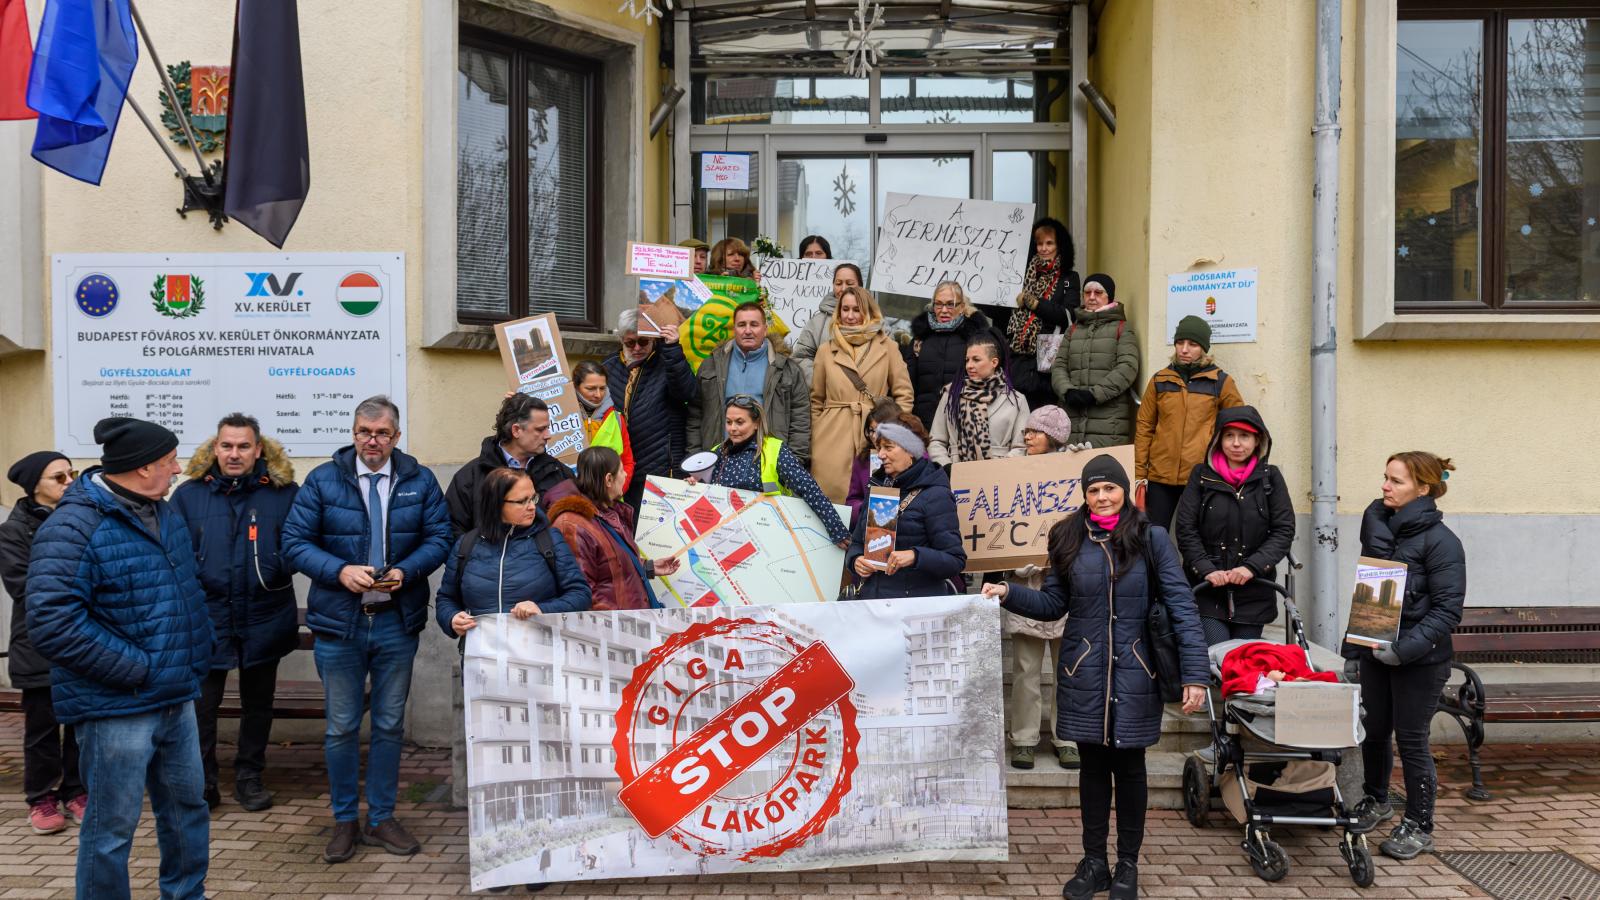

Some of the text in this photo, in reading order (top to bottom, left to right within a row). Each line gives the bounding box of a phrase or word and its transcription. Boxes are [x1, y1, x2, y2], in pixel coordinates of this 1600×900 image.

[713, 154, 727, 164] NE
[948, 201, 963, 221] A
[896, 217, 1014, 250] TERMÉSZET
[643, 257, 657, 267] TE
[933, 247, 980, 269] NEM
[762, 258, 816, 281] ZÖLDET
[792, 284, 831, 298] AKARU
[1170, 282, 1237, 293] ÖNKORMÁNYZAT
[234, 300, 311, 312] XV. KERÜLET
[773, 296, 795, 311] EM
[77, 328, 380, 342] BUDAPEST FŐVÁROS XV. KERÜLET ÖNKORMÁNYZATA
[143, 344, 315, 357] ÉS POLGÁRMESTERI HIVATALA
[100, 367, 192, 377] ÜGYFÉLSZOLGÁLAT
[268, 366, 356, 376] ÜGYFÉLFOGADÁS
[548, 415, 580, 433] heti
[547, 431, 583, 456] mainkat
[952, 478, 1081, 521] FALANSZ
[647, 648, 745, 726] GIGA
[670, 686, 796, 795] STOP
[700, 725, 828, 834] LAKÓPARK
